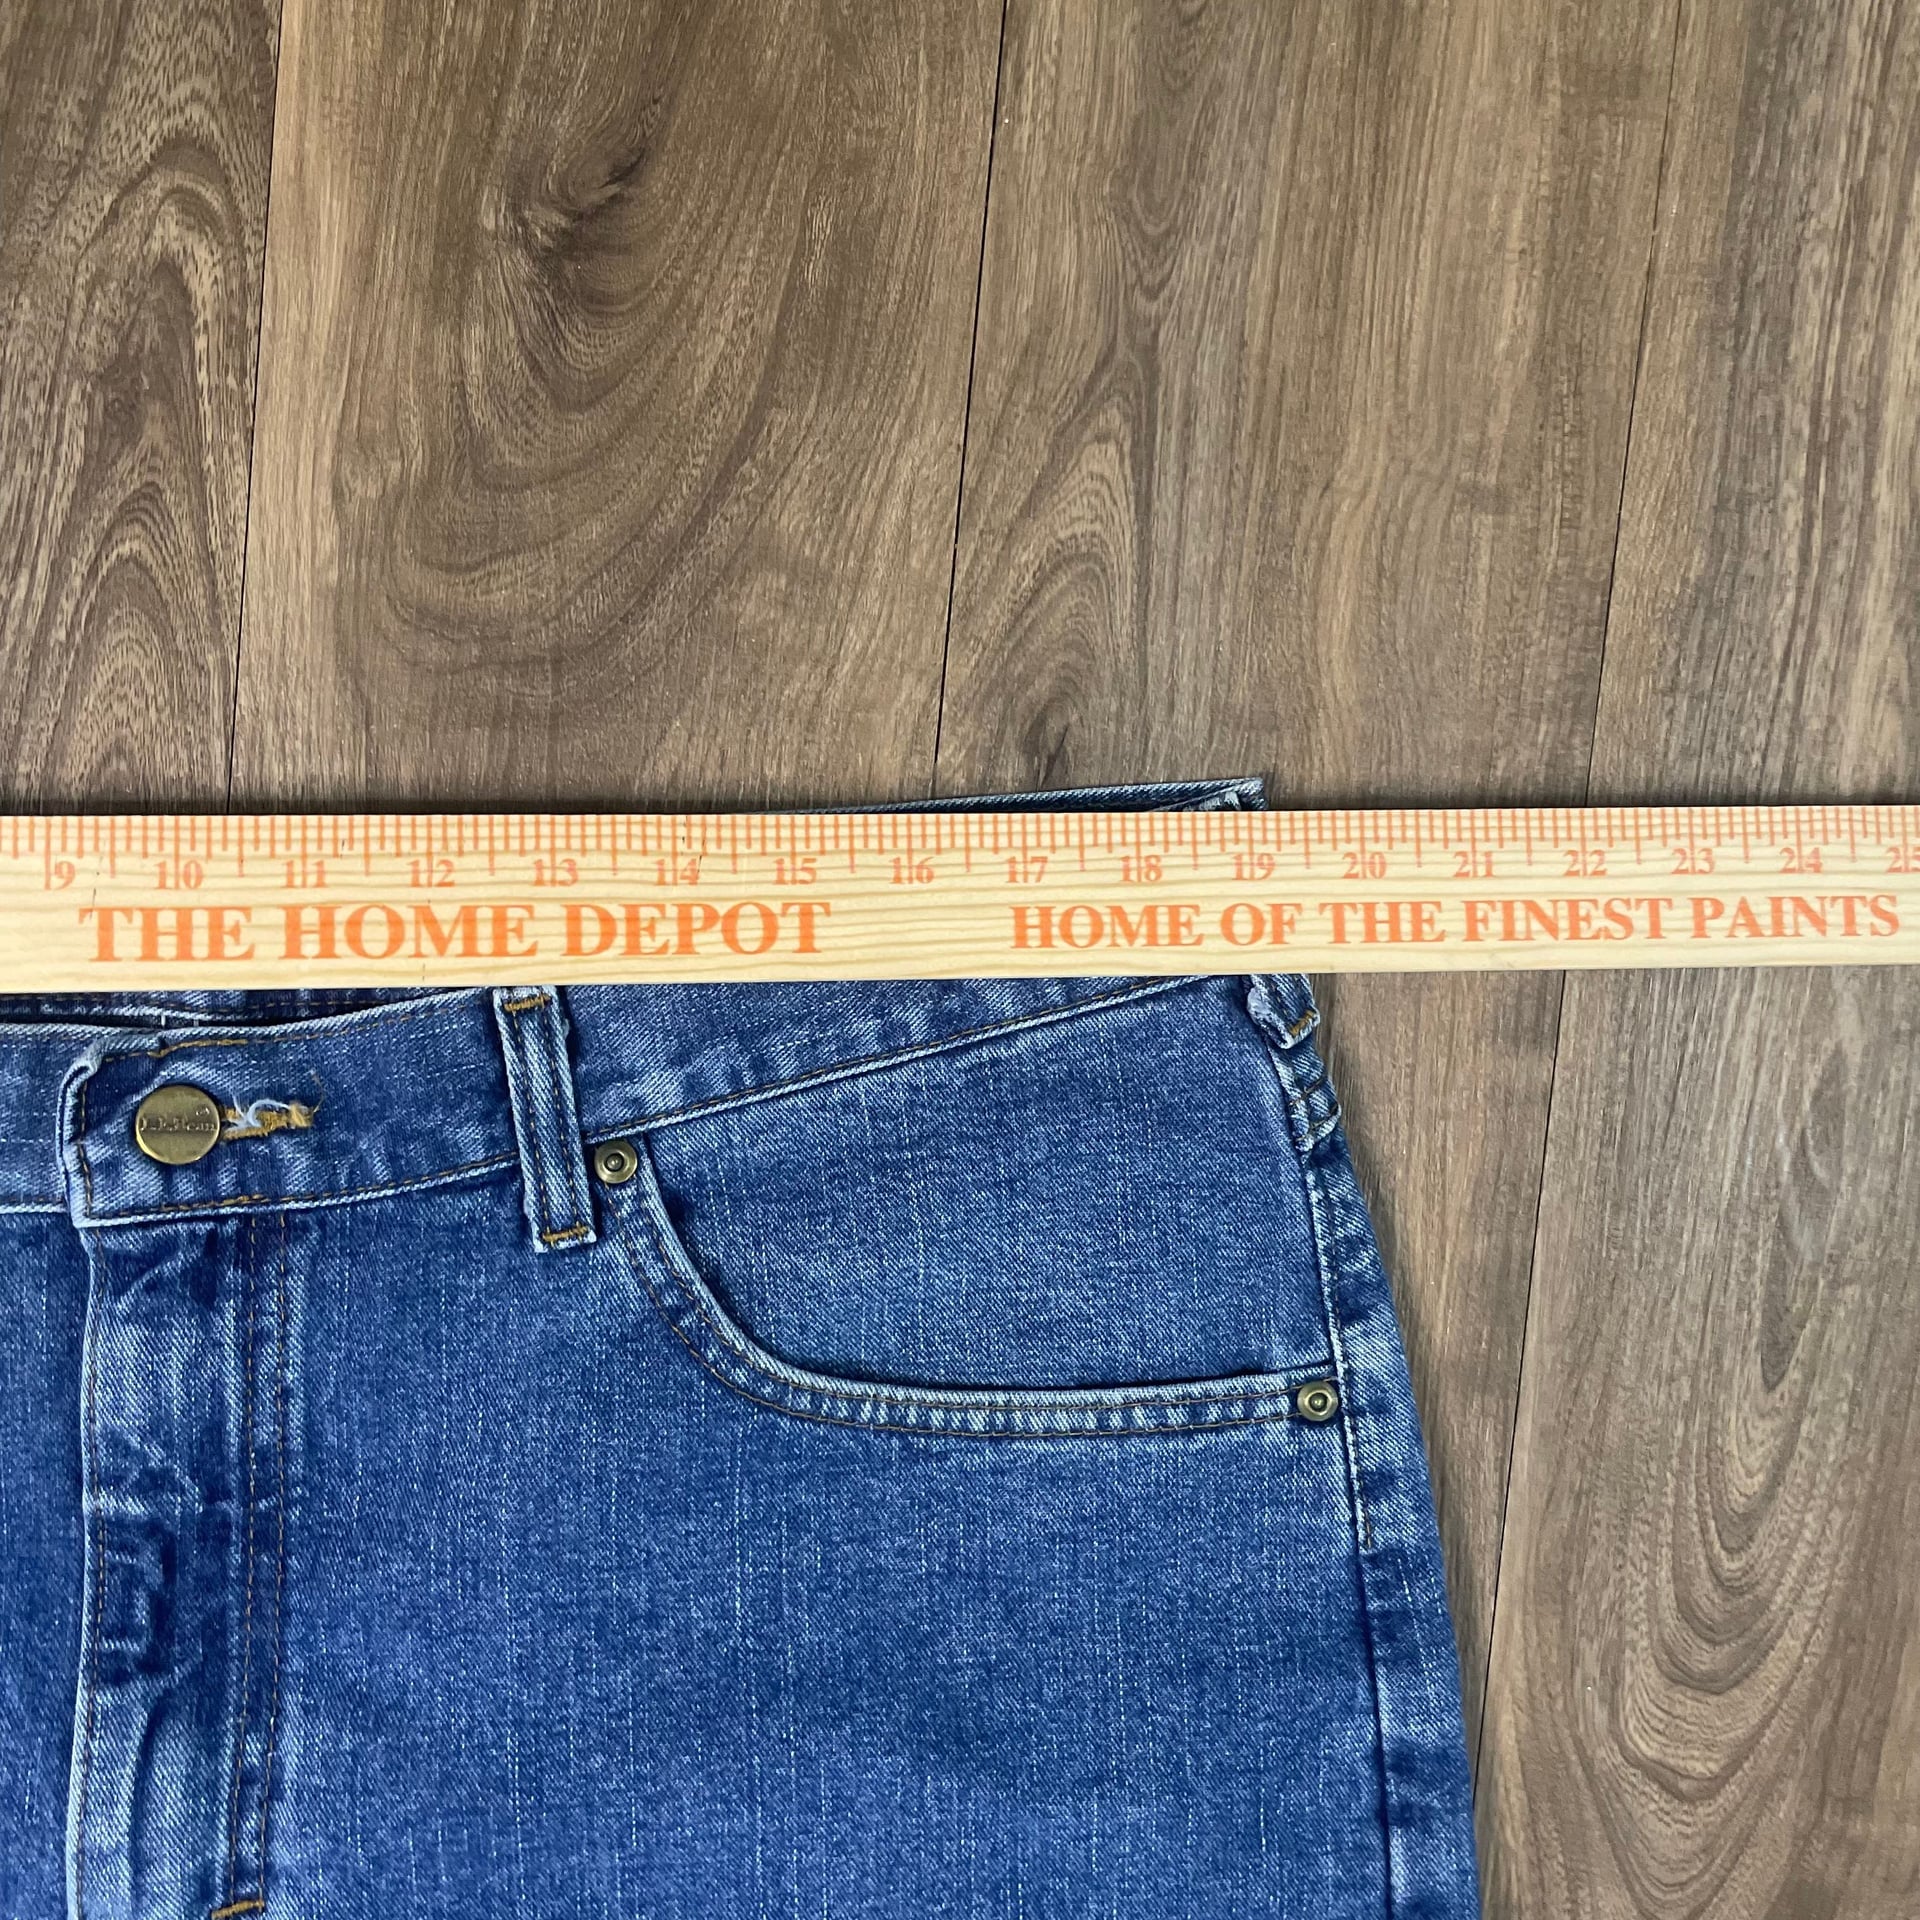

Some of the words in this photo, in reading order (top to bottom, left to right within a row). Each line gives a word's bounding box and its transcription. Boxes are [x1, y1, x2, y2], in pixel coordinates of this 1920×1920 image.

[54, 863, 76, 890] 9
[156, 861, 204, 890] 10
[284, 860, 328, 889] 11
[408, 859, 456, 888] 12
[532, 858, 579, 888] 13
[656, 858, 699, 887] 14
[773, 857, 817, 886] 15
[891, 856, 935, 885] 16
[1007, 855, 1049, 884] 17
[1121, 855, 1163, 883] 18
[1234, 853, 1276, 882] 19
[1344, 852, 1388, 881] 20
[1454, 850, 1494, 879] 21
[1564, 849, 1607, 878] 22
[1671, 847, 1714, 876] 23
[1780, 846, 1822, 875] 24
[79, 906, 256, 963] THE
[278, 902, 538, 961] HOME
[561, 900, 832, 958] DEPOT
[1011, 904, 1205, 950] HOME
[1219, 902, 1304, 946] OF
[1317, 901, 1446, 944] THE
[1463, 899, 1673, 943] FINEST
[1690, 895, 1900, 939] PAINTS
